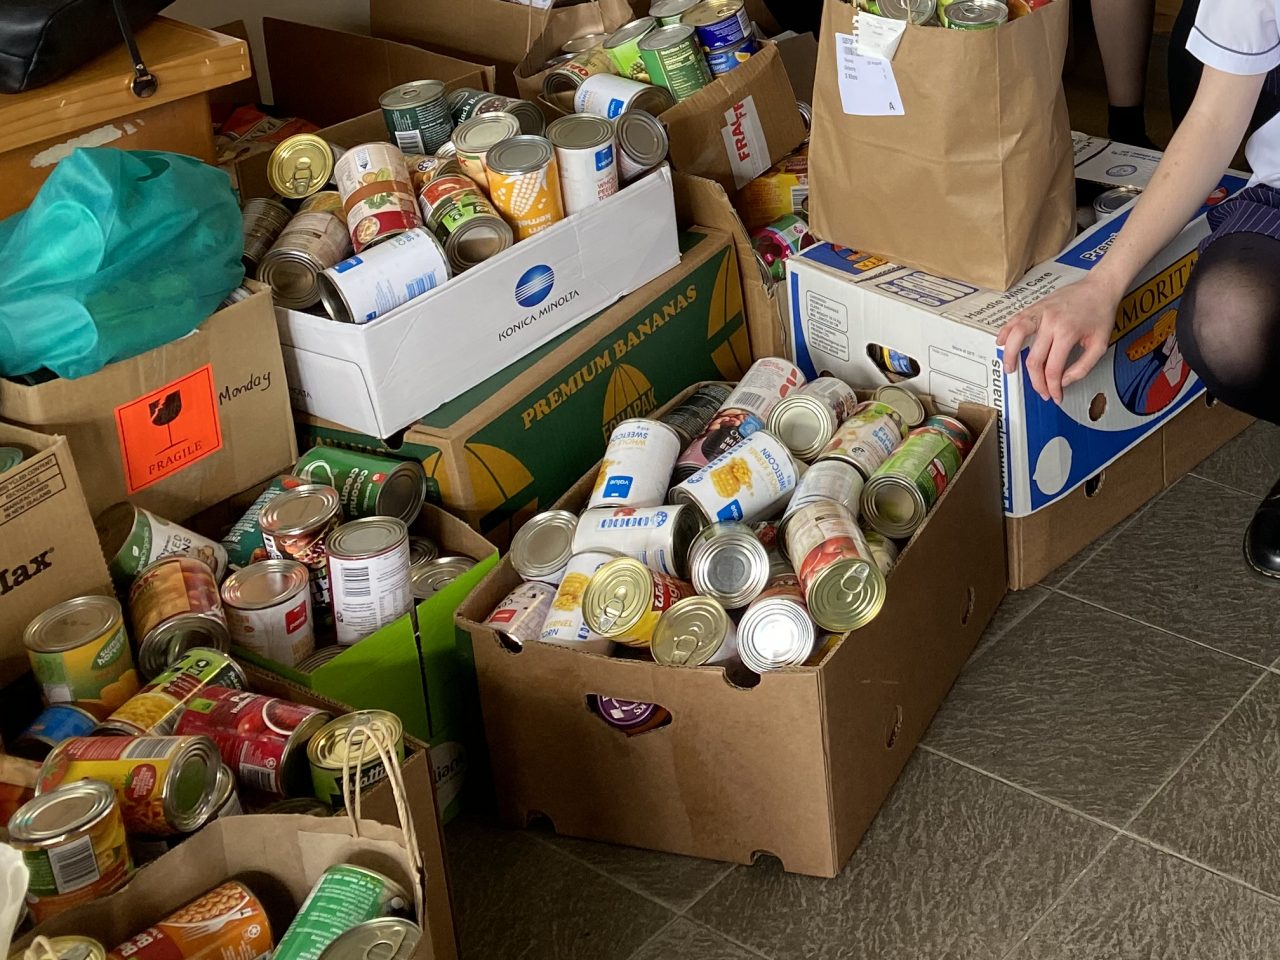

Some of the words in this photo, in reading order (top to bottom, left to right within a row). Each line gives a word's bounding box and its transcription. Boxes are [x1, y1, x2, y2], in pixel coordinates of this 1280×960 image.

[1080, 232, 1119, 261] Prem
[498, 314, 537, 342] KONICA
[539, 288, 580, 317] MINOLTA
[964, 299, 1004, 320] Handle
[1026, 272, 1053, 288] Care
[521, 350, 611, 429] PREMIUM
[613, 285, 698, 359] BANANAS
[219, 368, 272, 406] Monday
[148, 440, 204, 476] FRAGILE
[609, 478, 630, 487] value
